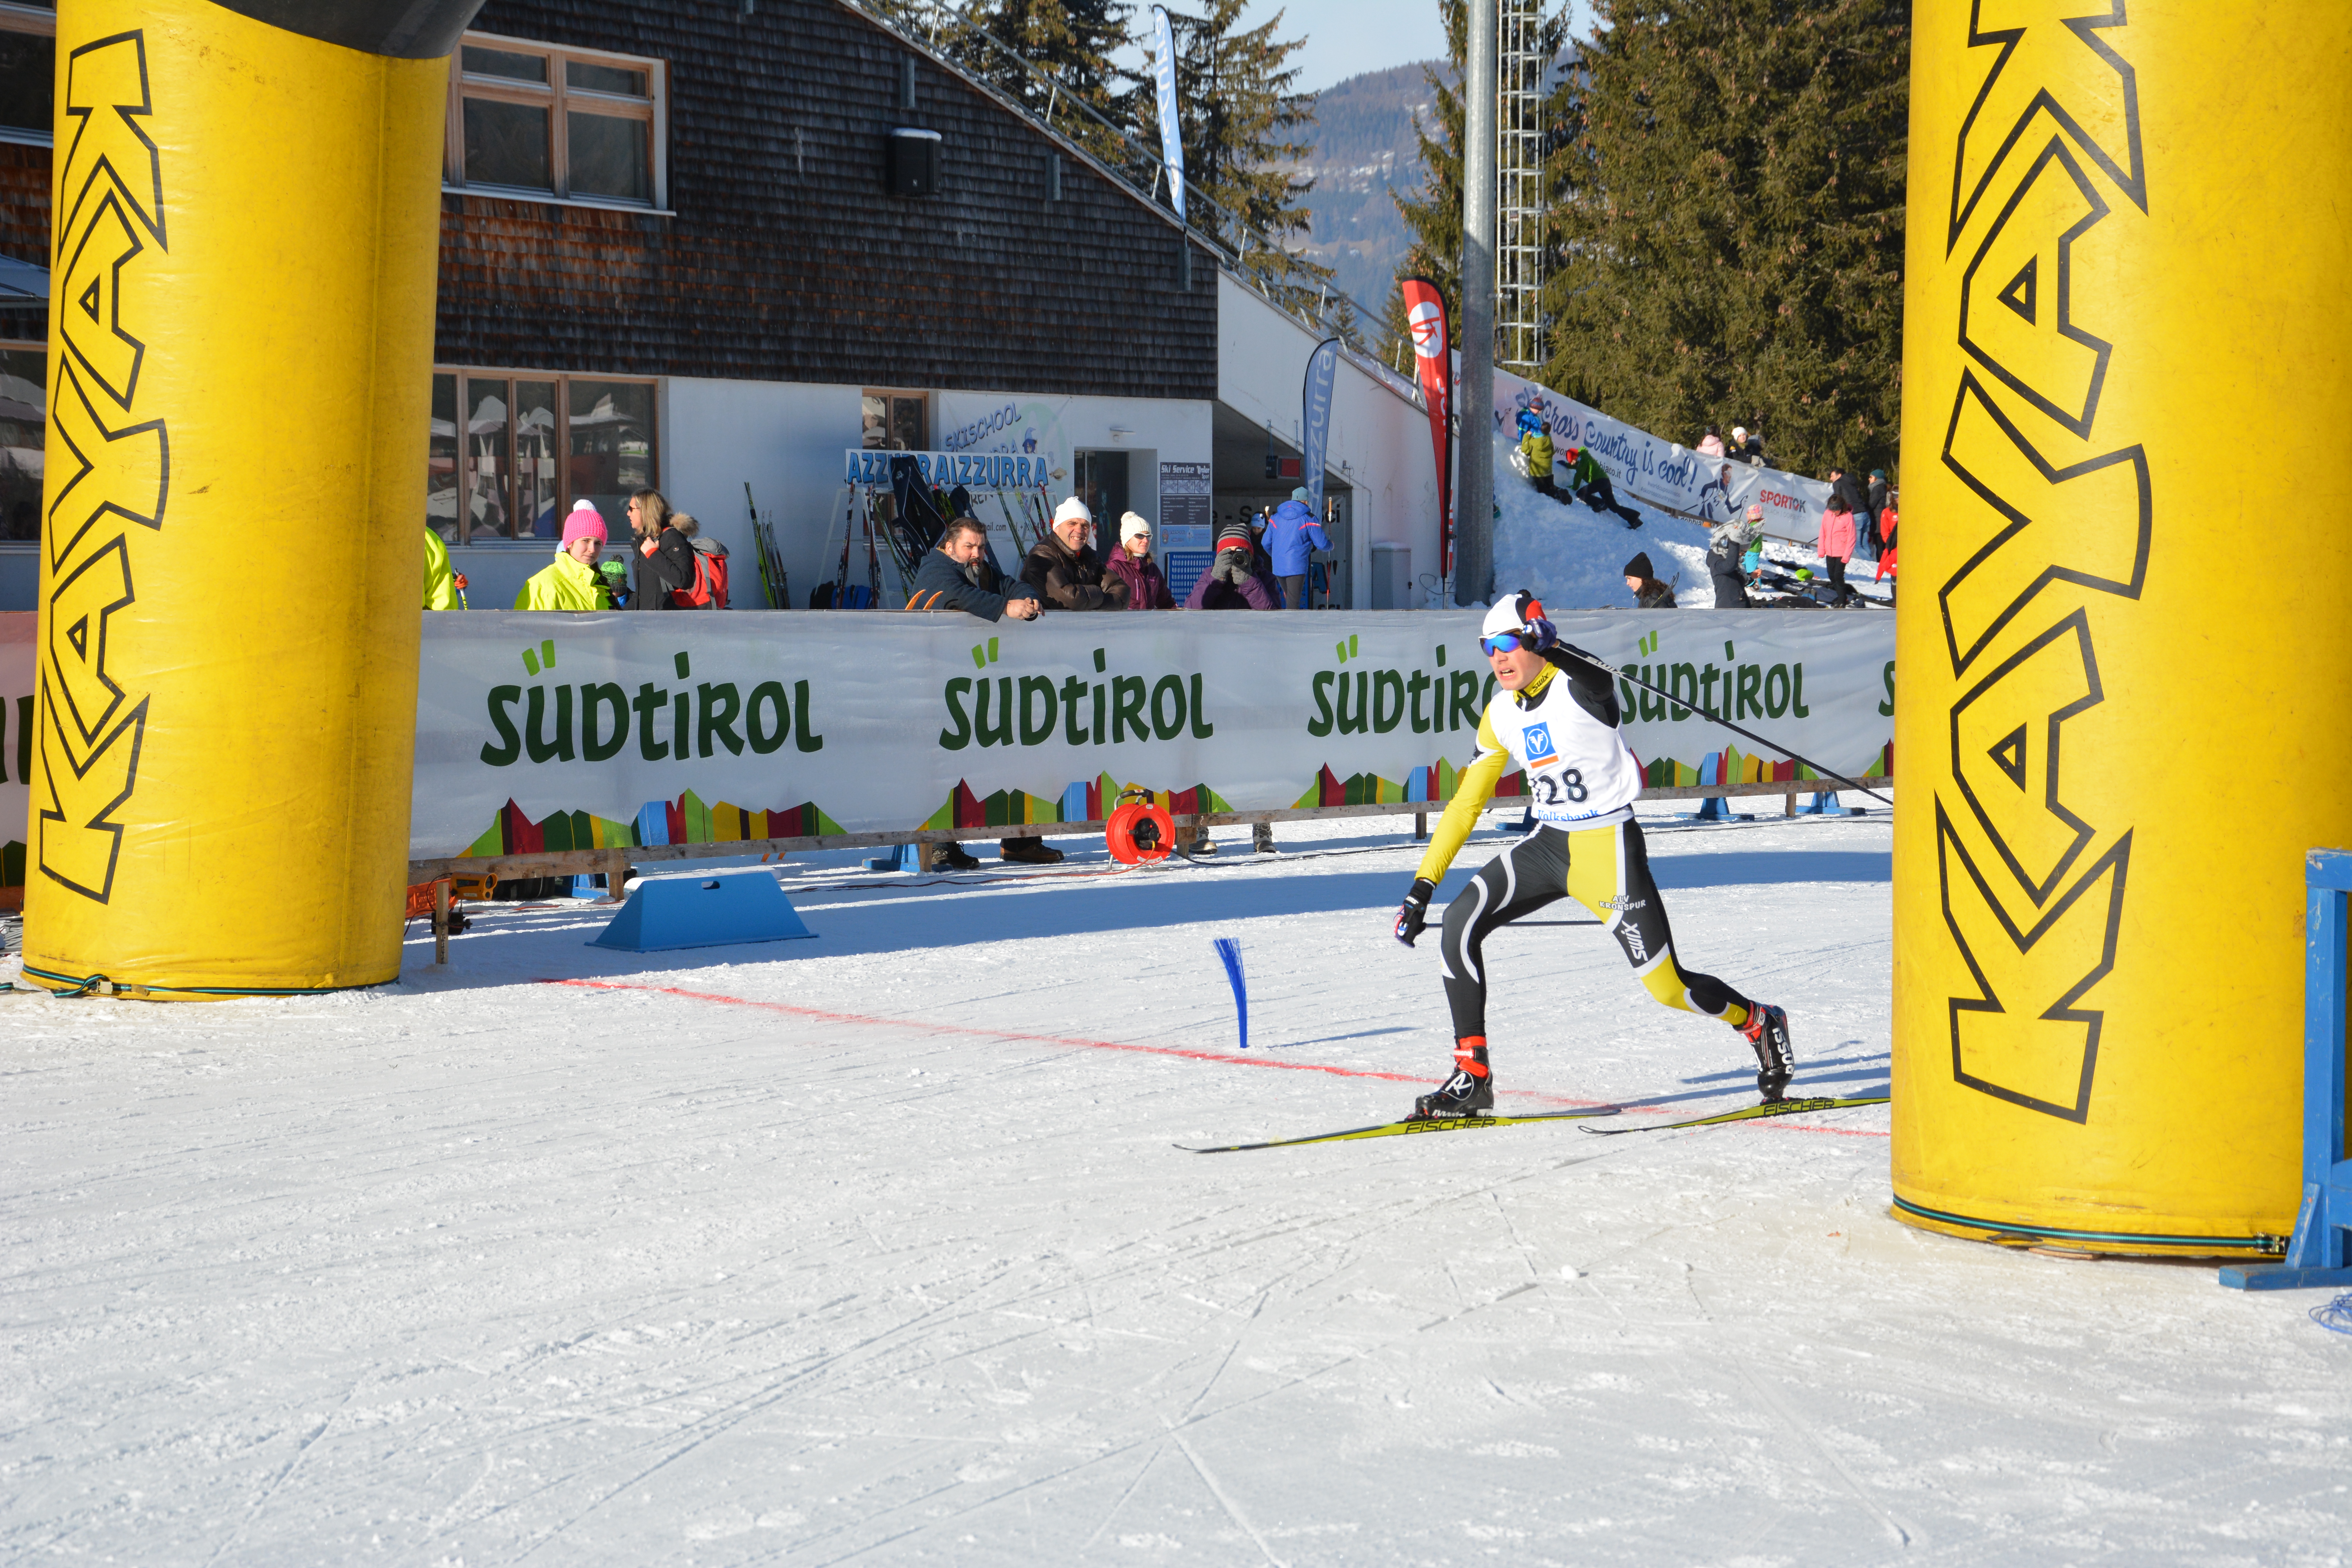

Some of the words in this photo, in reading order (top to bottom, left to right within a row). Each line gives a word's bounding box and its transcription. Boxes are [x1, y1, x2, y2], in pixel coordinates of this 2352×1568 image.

[945, 401, 1022, 452] SKISCHOOL
[1584, 421, 1639, 486] Country
[1642, 441, 1654, 475] is
[38, 29, 170, 906] KAYAK
[1161, 465, 1171, 473] Ski
[1172, 465, 1194, 474] Service
[1760, 489, 1806, 514] SPORTOK
[1599, 899, 1646, 911] KRONSPUR
[1764, 1100, 1835, 1116] FISCHER
[1405, 1118, 1497, 1134] FISCHER
